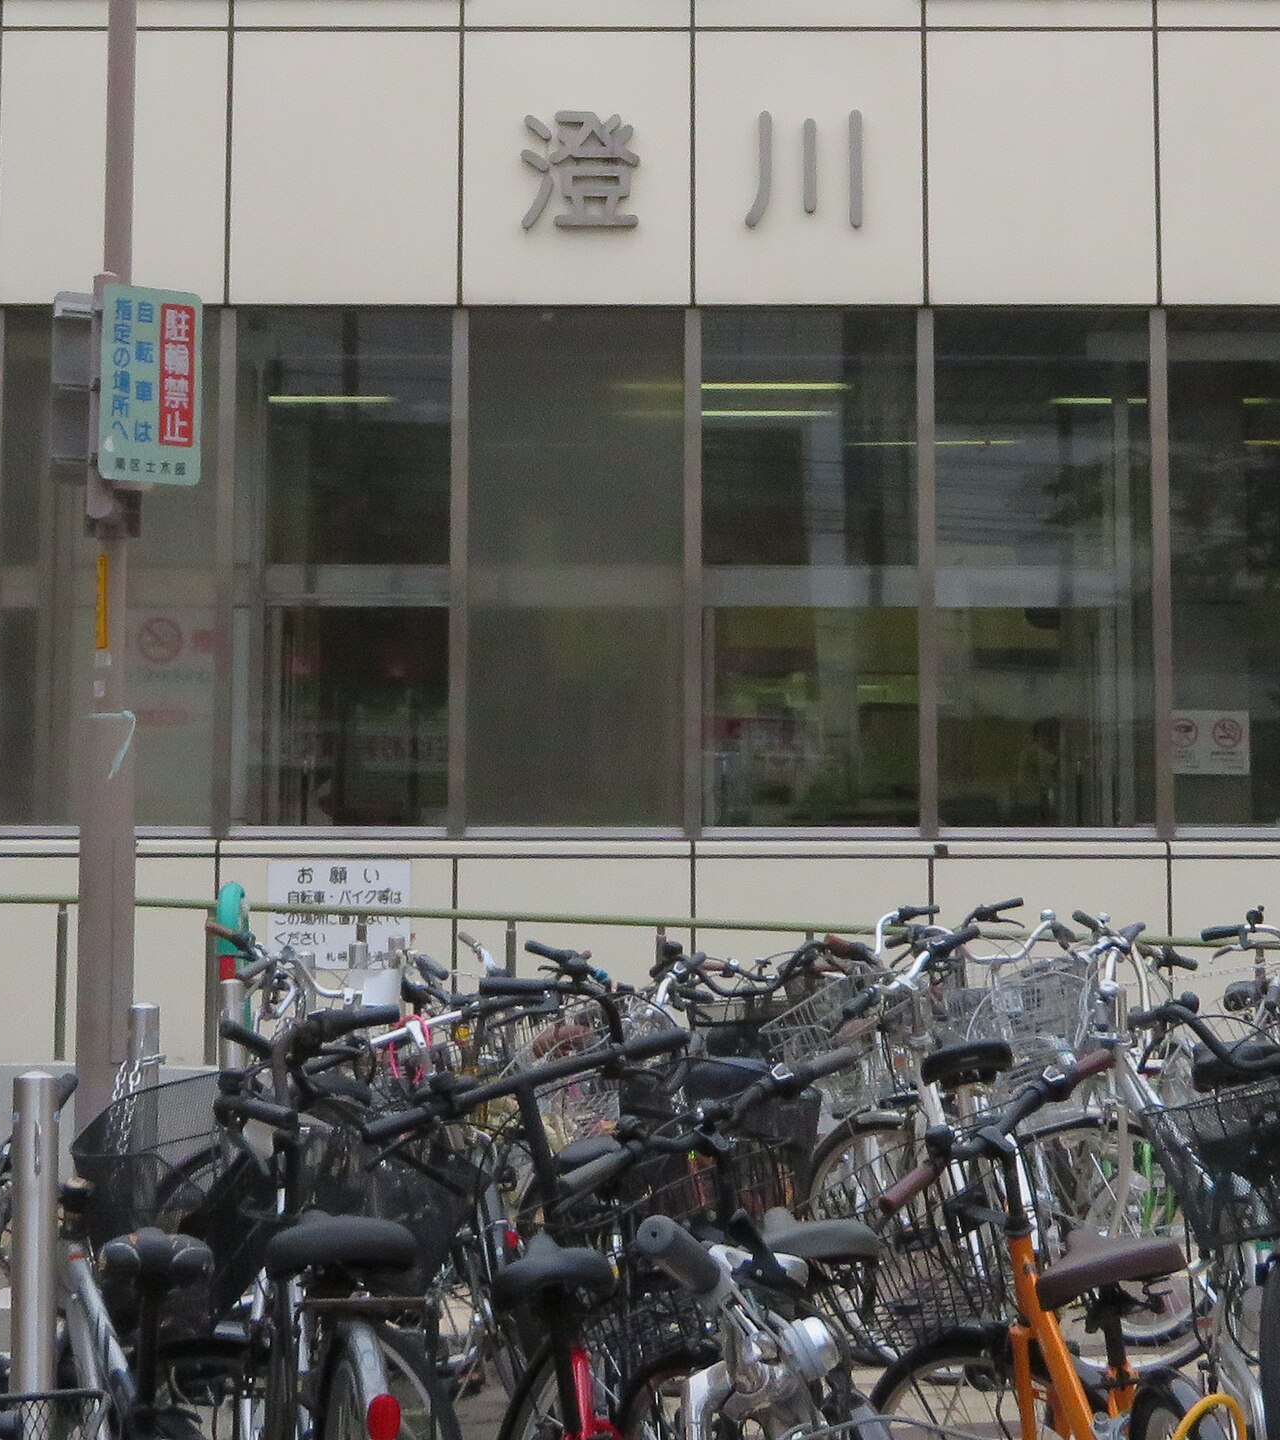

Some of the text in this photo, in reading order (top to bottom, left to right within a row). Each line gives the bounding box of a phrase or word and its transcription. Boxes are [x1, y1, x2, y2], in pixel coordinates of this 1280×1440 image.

[520, 110, 863, 229] 澄川
[111, 298, 132, 441] 指定の場所へ
[134, 300, 154, 443] 自転車は
[297, 866, 380, 884] お願い
[274, 931, 326, 945] ください
